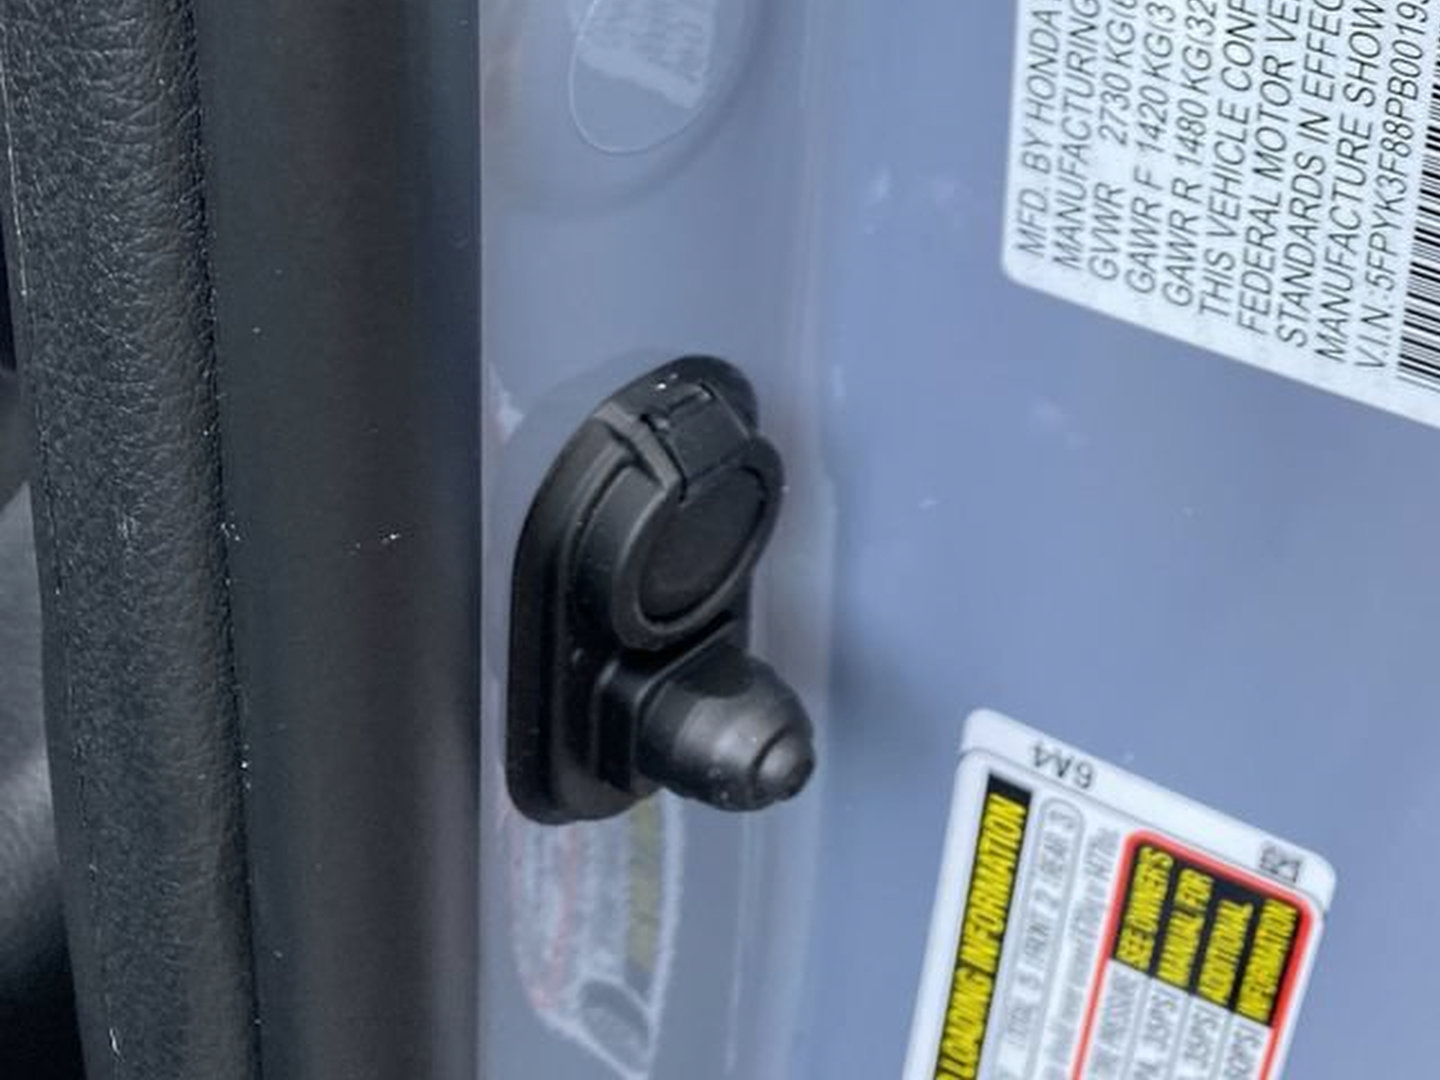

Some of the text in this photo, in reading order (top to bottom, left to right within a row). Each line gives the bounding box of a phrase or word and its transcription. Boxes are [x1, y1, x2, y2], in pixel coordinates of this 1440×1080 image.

[1024, 9, 1062, 125] HONDA
[1096, 70, 1132, 147] 2730
[1019, 126, 1052, 175] BY
[1134, 84, 1170, 153] 1420
[1173, 97, 1209, 166] 1480
[1205, 97, 1250, 237] VEHICLE
[1251, 53, 1295, 182] MOTOR
[1296, 106, 1331, 144] IN
[1014, 178, 1049, 258] MFD.
[1132, 164, 1163, 191] F
[1169, 176, 1203, 204] R
[1086, 181, 1126, 281] GVWR
[1123, 195, 1162, 294] GAWR
[1160, 208, 1200, 307] GAWR
[1236, 191, 1282, 335] FEDERAL
[1274, 150, 1327, 348] STANDARDS
[1313, 112, 1373, 363] MANUFACTURE
[1197, 247, 1236, 317] THIS
[961, 793, 1026, 973] INFORMATION
[1157, 868, 1213, 987] MANUAL FOR
[1117, 925, 1155, 970] SEE
[1200, 899, 1253, 1005] ADDITIONAL
[1237, 898, 1299, 1022] INFORMATION
[938, 965, 995, 1077] LOADING
